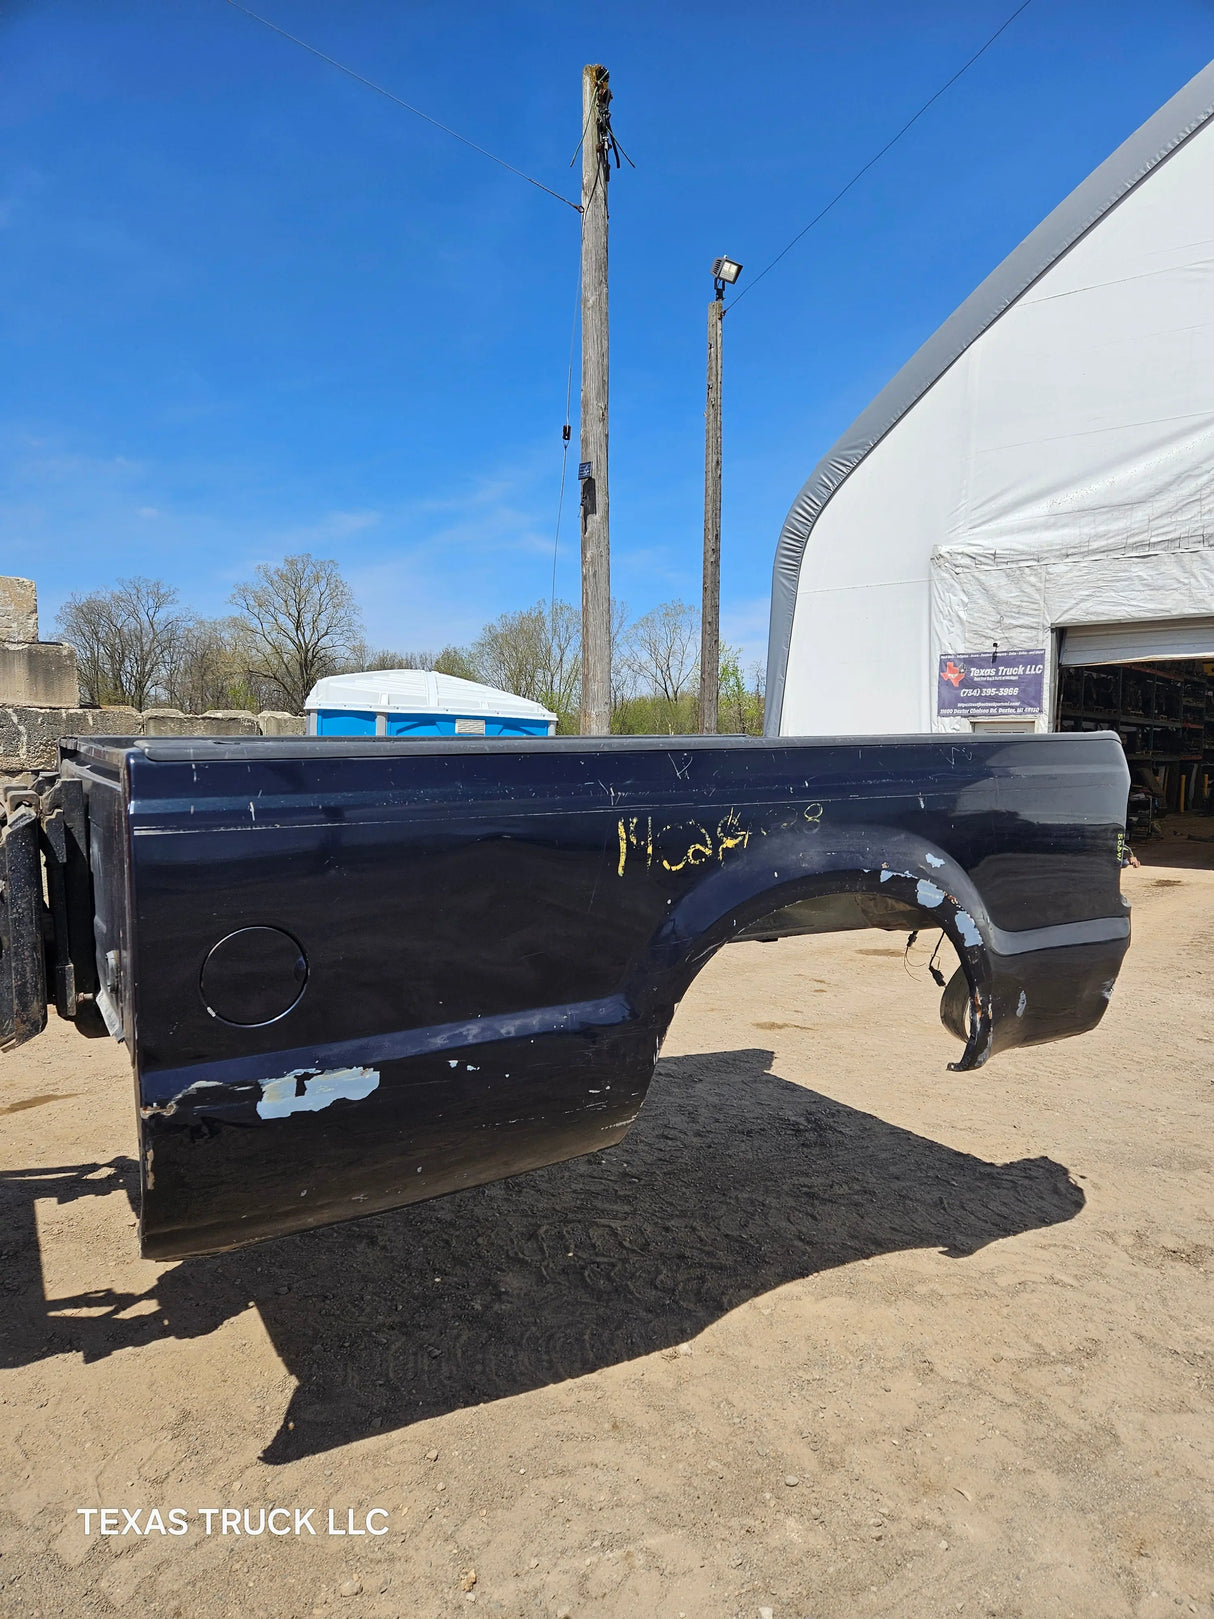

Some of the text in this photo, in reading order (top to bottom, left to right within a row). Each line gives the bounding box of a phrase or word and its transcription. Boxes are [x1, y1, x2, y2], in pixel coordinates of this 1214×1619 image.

[970, 667, 995, 677] Texas
[998, 665, 1025, 676] Truck
[1025, 664, 1043, 674] LLC
